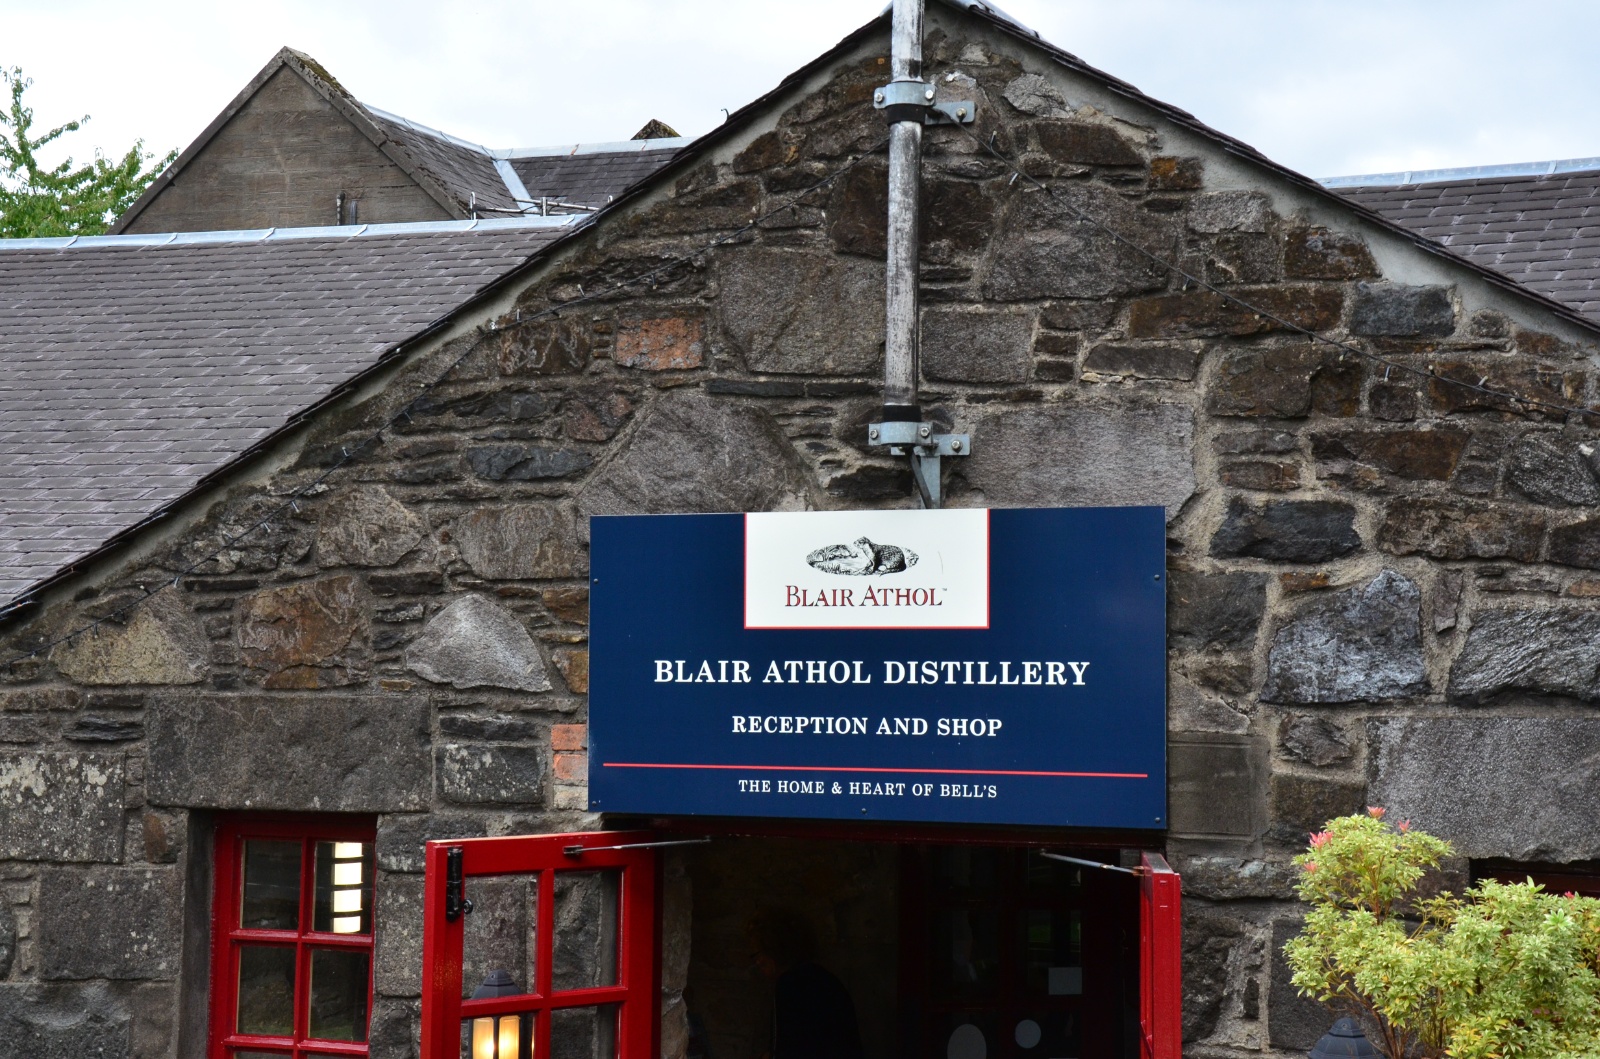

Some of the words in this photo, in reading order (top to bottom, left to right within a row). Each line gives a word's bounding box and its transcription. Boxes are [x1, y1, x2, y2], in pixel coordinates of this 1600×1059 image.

[785, 585, 855, 607] BLAIR
[653, 659, 752, 684] BLAIR
[763, 659, 872, 685] ATHOL
[883, 660, 1091, 687] DISTILLERY
[731, 715, 869, 736] RECEPTION
[875, 716, 929, 737] AND
[936, 717, 1003, 738] SHOP
[738, 779, 771, 794] THE
[777, 780, 825, 795] HOME
[831, 781, 843, 795] &
[848, 781, 906, 797] HEART
[911, 783, 934, 798] OF
[939, 783, 998, 799] BELL'S
